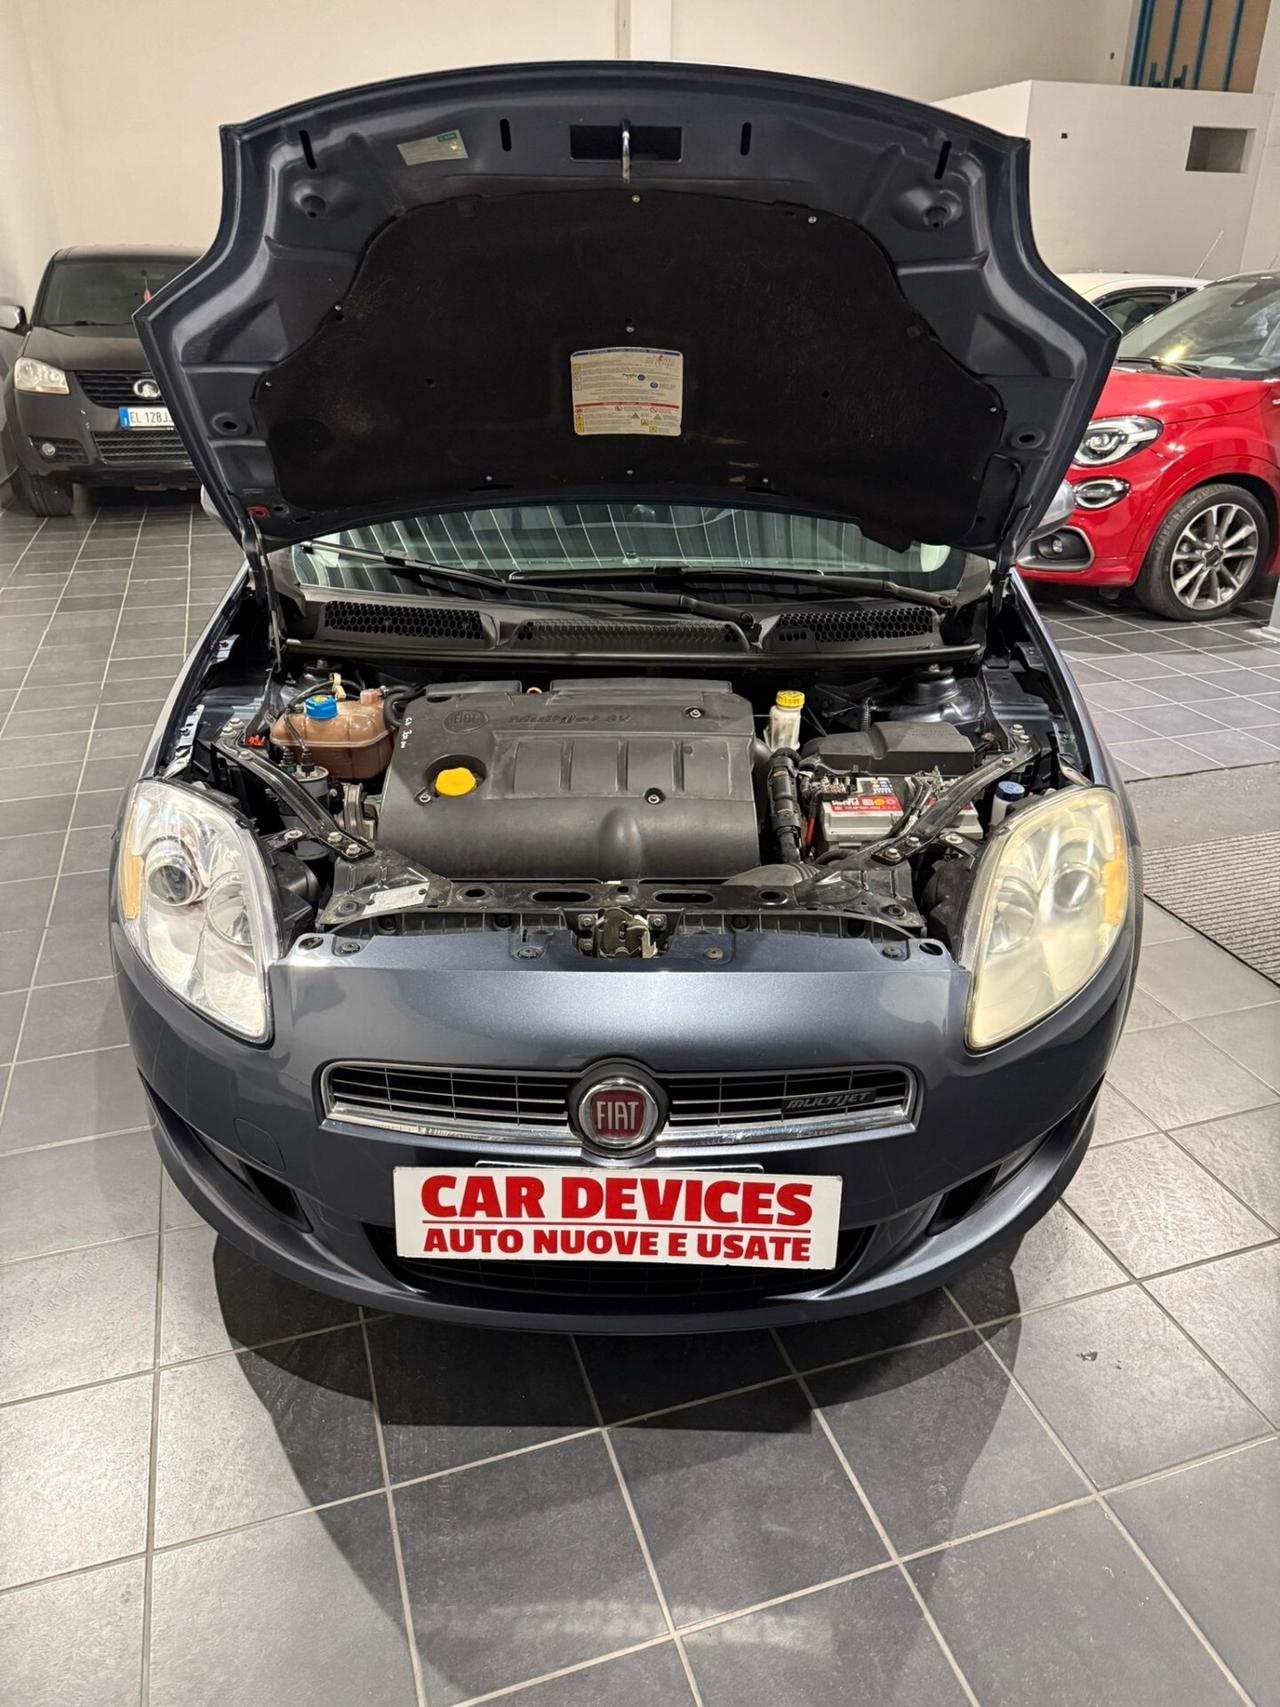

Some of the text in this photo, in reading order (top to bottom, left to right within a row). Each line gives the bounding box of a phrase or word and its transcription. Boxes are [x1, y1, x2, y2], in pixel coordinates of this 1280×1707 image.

[130, 411, 142, 424] EL
[786, 1091, 872, 1110] MULTIJET
[596, 1101, 639, 1130] FIAT
[421, 1174, 813, 1227] CAR DEVICES
[423, 1228, 811, 1263] AUTO NUOVE E USATE
